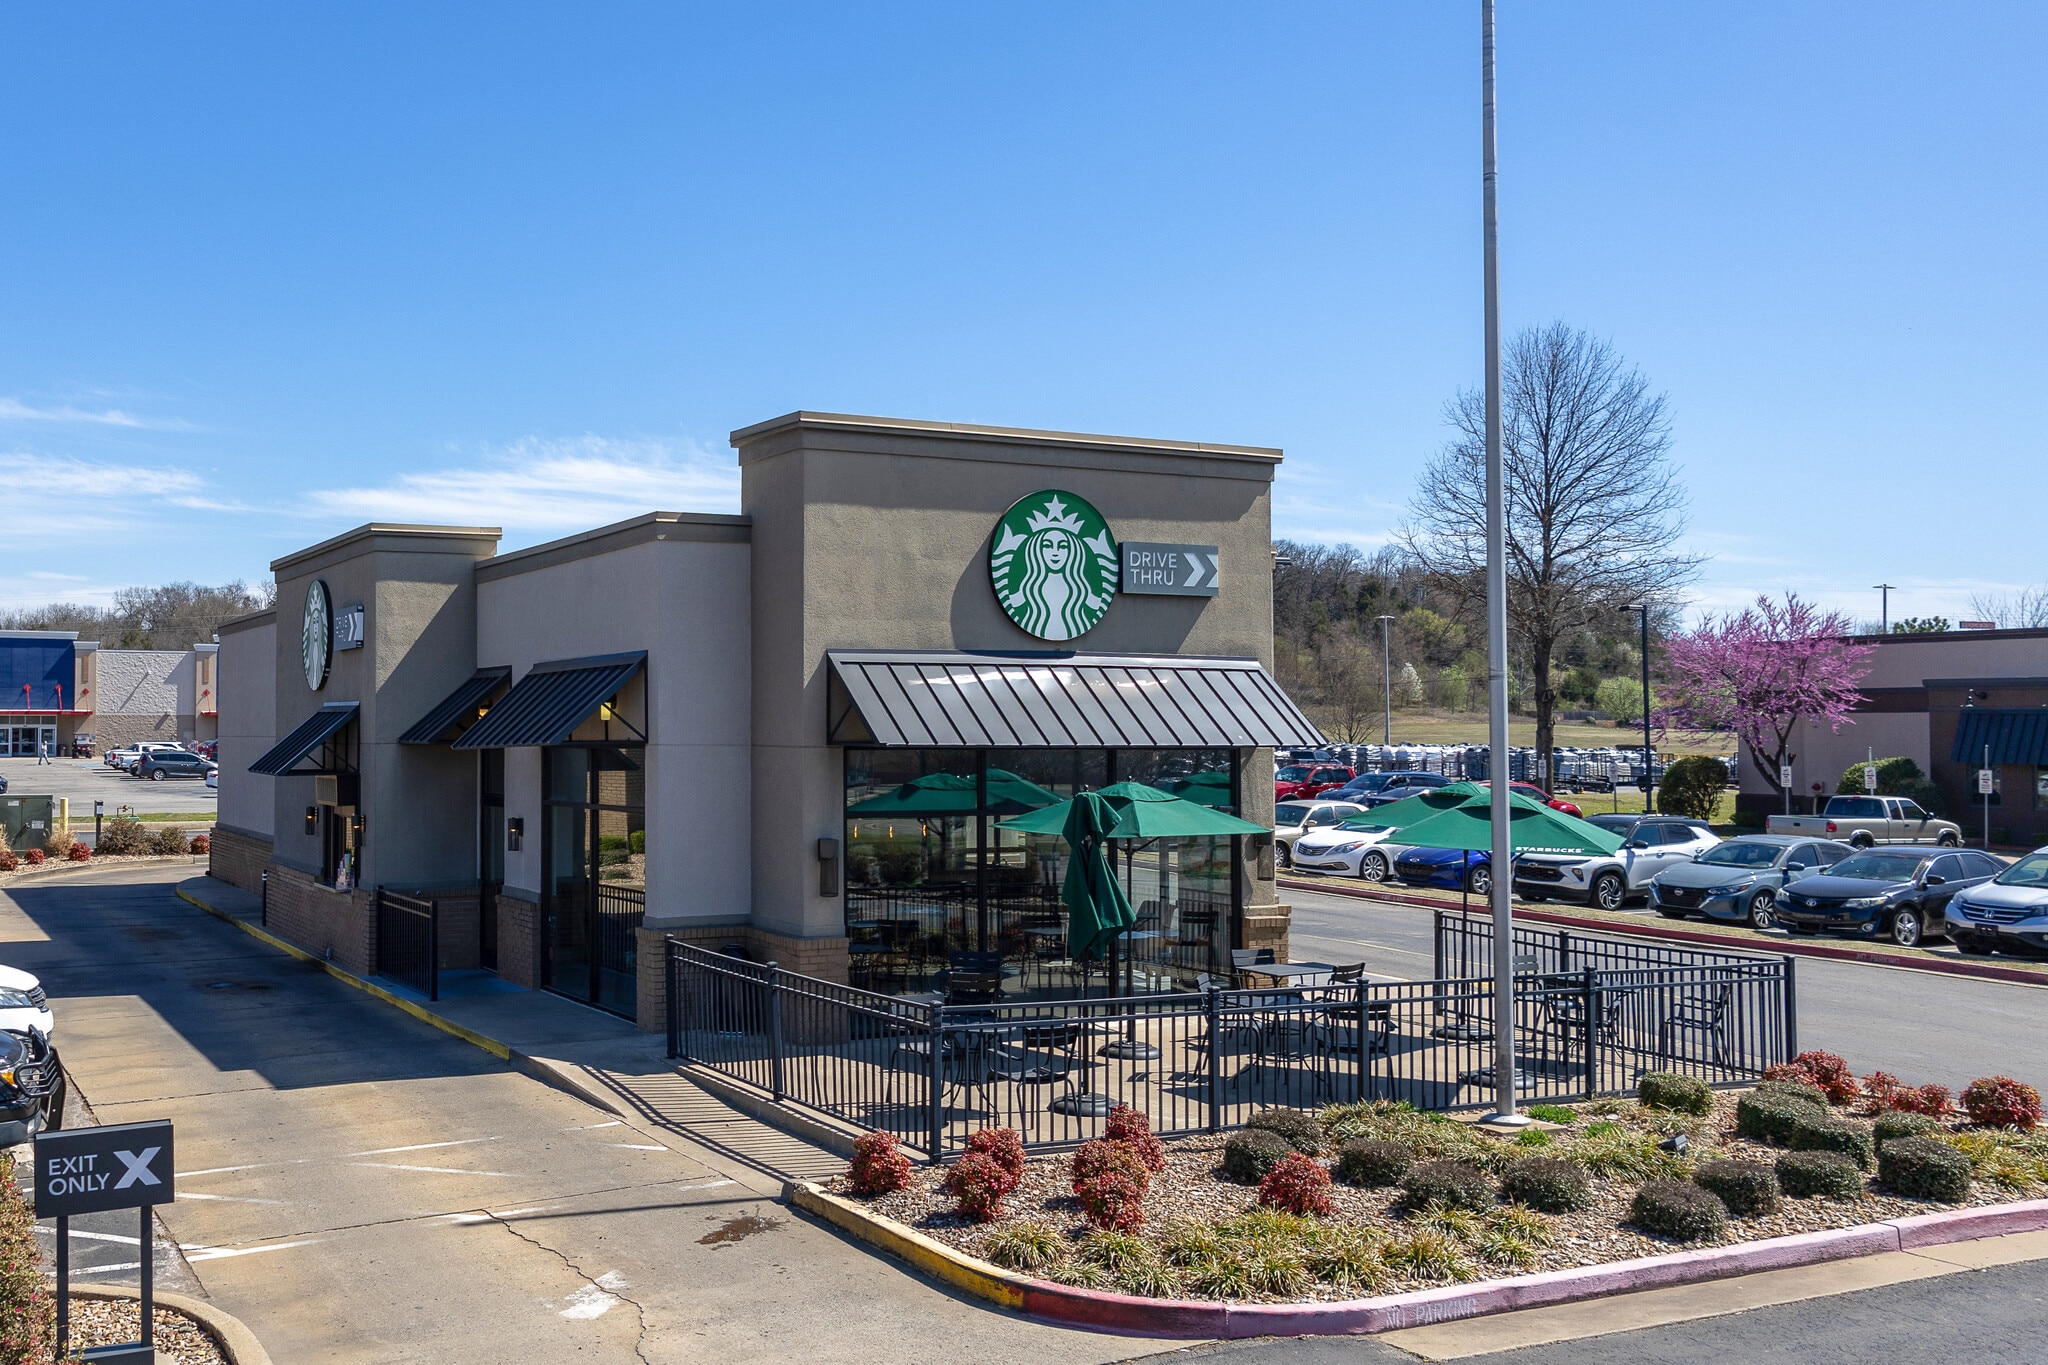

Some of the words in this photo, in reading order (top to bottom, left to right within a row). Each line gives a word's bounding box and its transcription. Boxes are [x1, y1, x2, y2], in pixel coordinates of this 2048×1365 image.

[1130, 551, 1177, 568] DRIVE
[1130, 569, 1174, 586] THRU
[48, 1154, 98, 1176] EXIT
[48, 1172, 111, 1196] ONLY
[1415, 1298, 1478, 1325] PARKING
